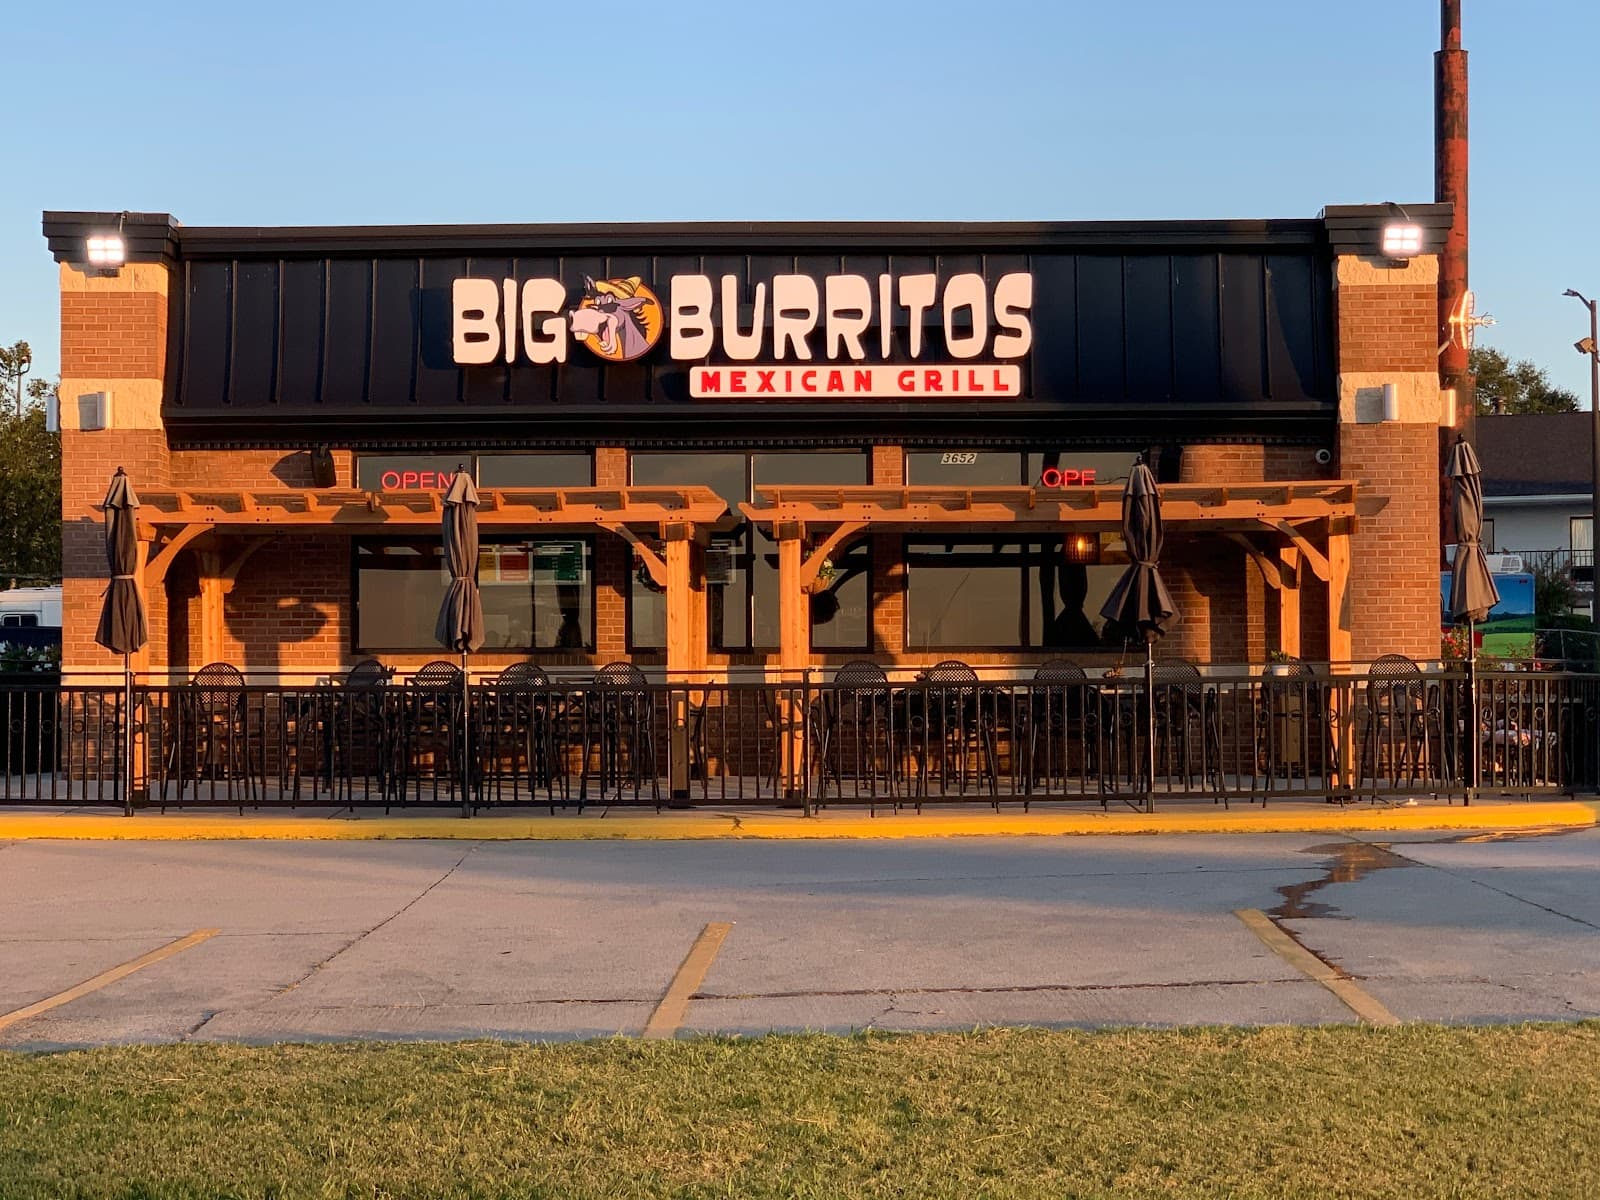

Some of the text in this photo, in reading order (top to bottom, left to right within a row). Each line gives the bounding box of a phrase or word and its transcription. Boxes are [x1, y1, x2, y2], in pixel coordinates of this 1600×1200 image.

[453, 272, 1033, 364] BIG BURRITOS
[702, 370, 1009, 392] MEXICAN GRILL
[942, 453, 976, 463] 3652
[381, 471, 454, 489] OPEN
